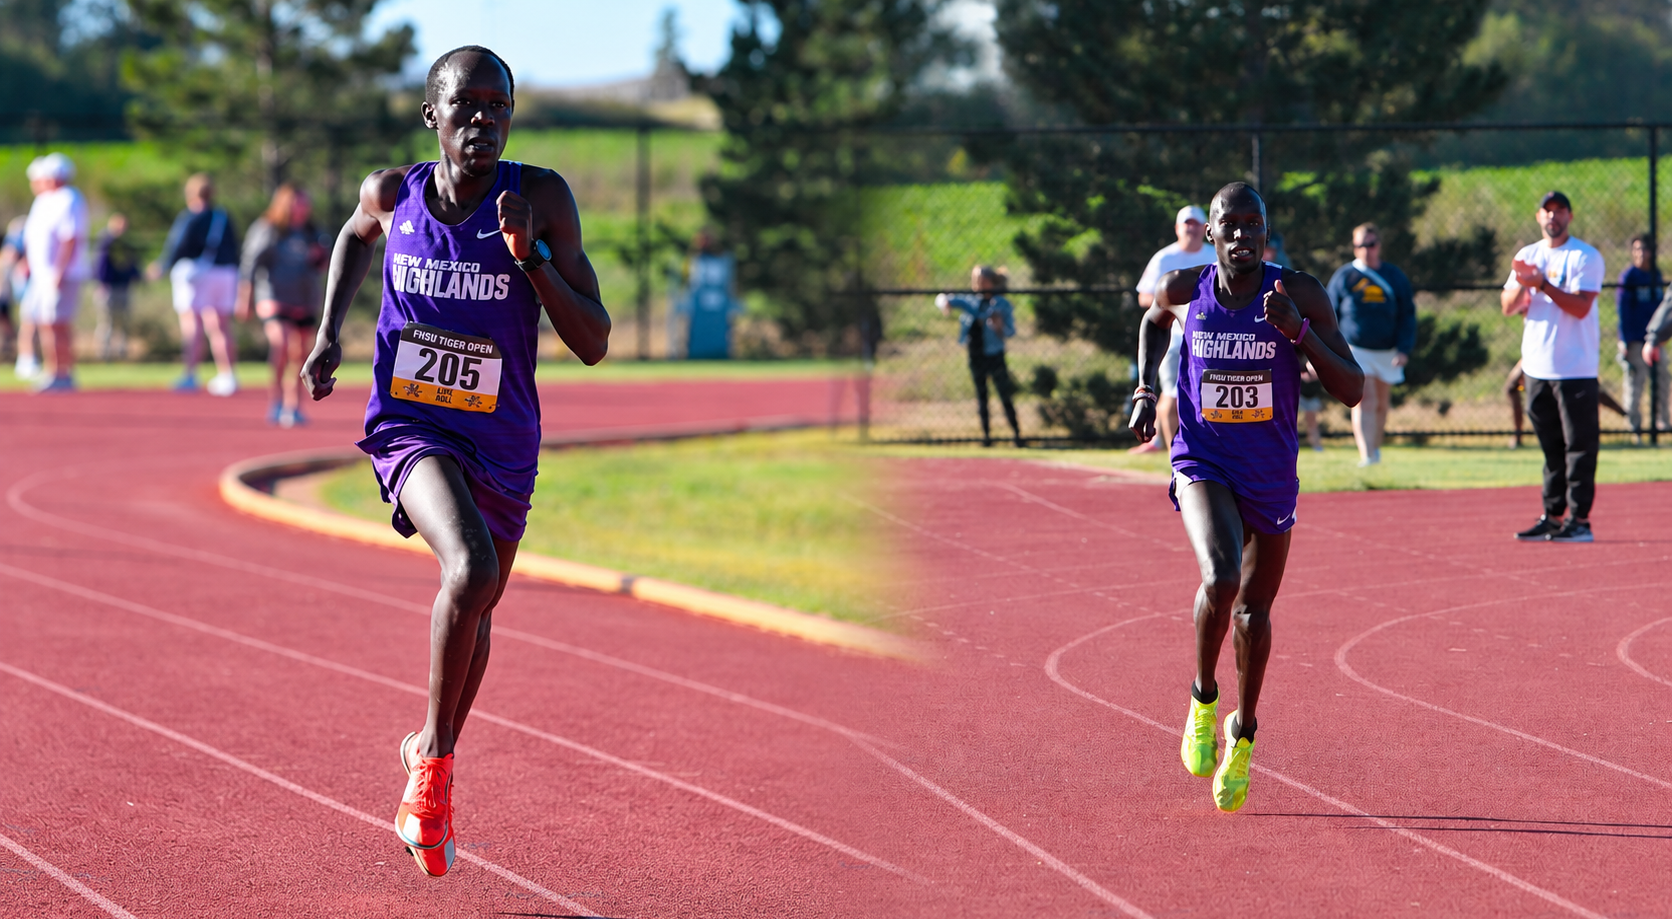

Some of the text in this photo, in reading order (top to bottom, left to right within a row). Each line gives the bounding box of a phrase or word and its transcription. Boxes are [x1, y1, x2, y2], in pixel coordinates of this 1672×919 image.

[425, 259, 481, 273] MEXICO
[413, 329, 493, 354] FHSU TIGER OPEN
[1192, 330, 1256, 341] NEW MEXICO
[1191, 339, 1277, 360] HIGHLANDS
[414, 347, 482, 391] 205
[1215, 385, 1259, 408] 203
